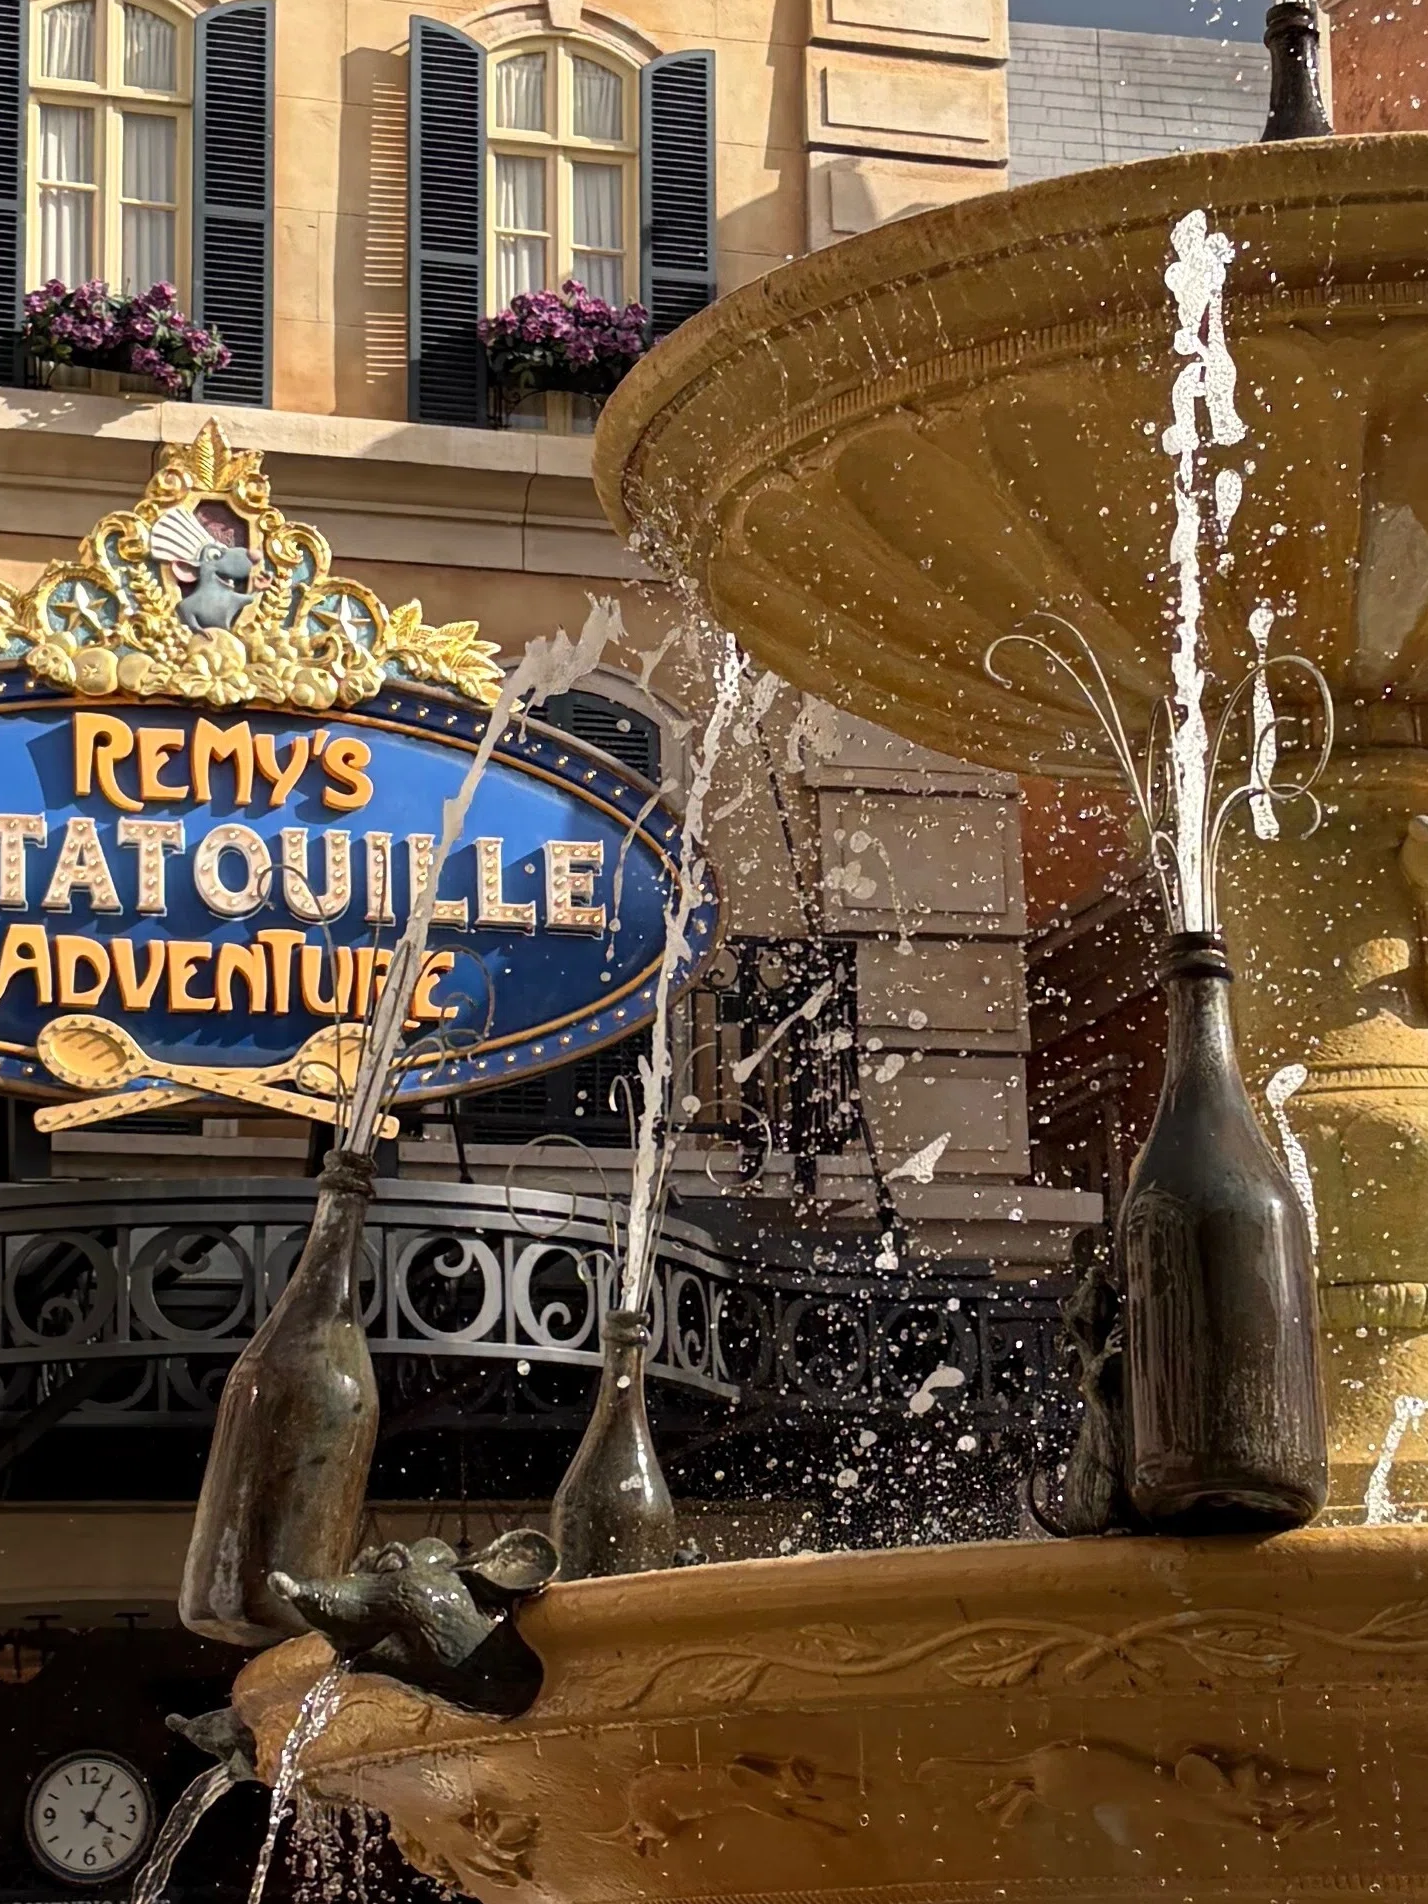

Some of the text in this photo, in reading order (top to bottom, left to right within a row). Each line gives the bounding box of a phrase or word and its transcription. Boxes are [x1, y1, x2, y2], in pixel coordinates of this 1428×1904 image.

[73, 711, 374, 812] REMY'S
[80, 1766, 102, 1784] 12
[43, 1804, 137, 1827] 9 3
[83, 1846, 96, 1866] 6
